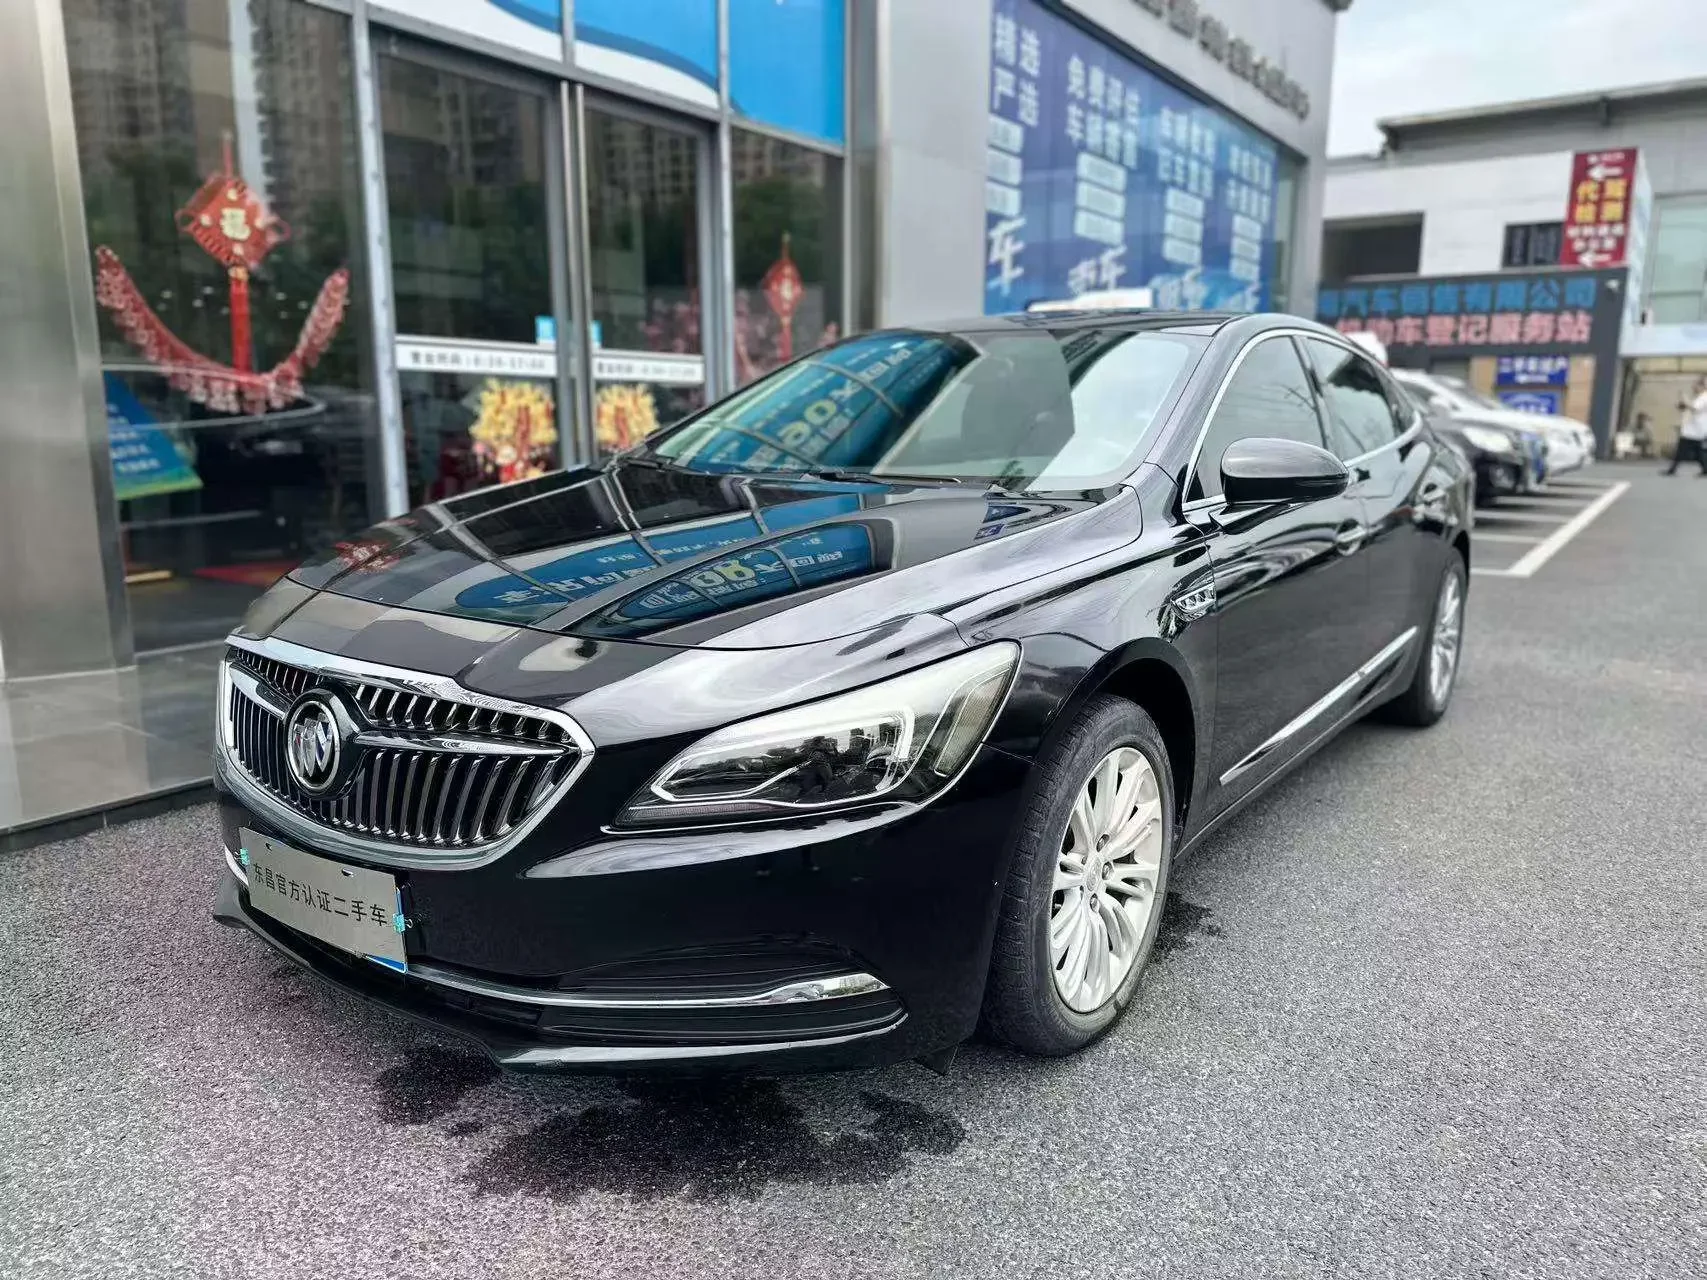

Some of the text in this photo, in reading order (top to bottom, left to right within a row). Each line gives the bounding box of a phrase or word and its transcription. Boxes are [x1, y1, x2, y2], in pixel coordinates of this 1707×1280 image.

[253, 862, 388, 927] 东昌官方认证二手车
